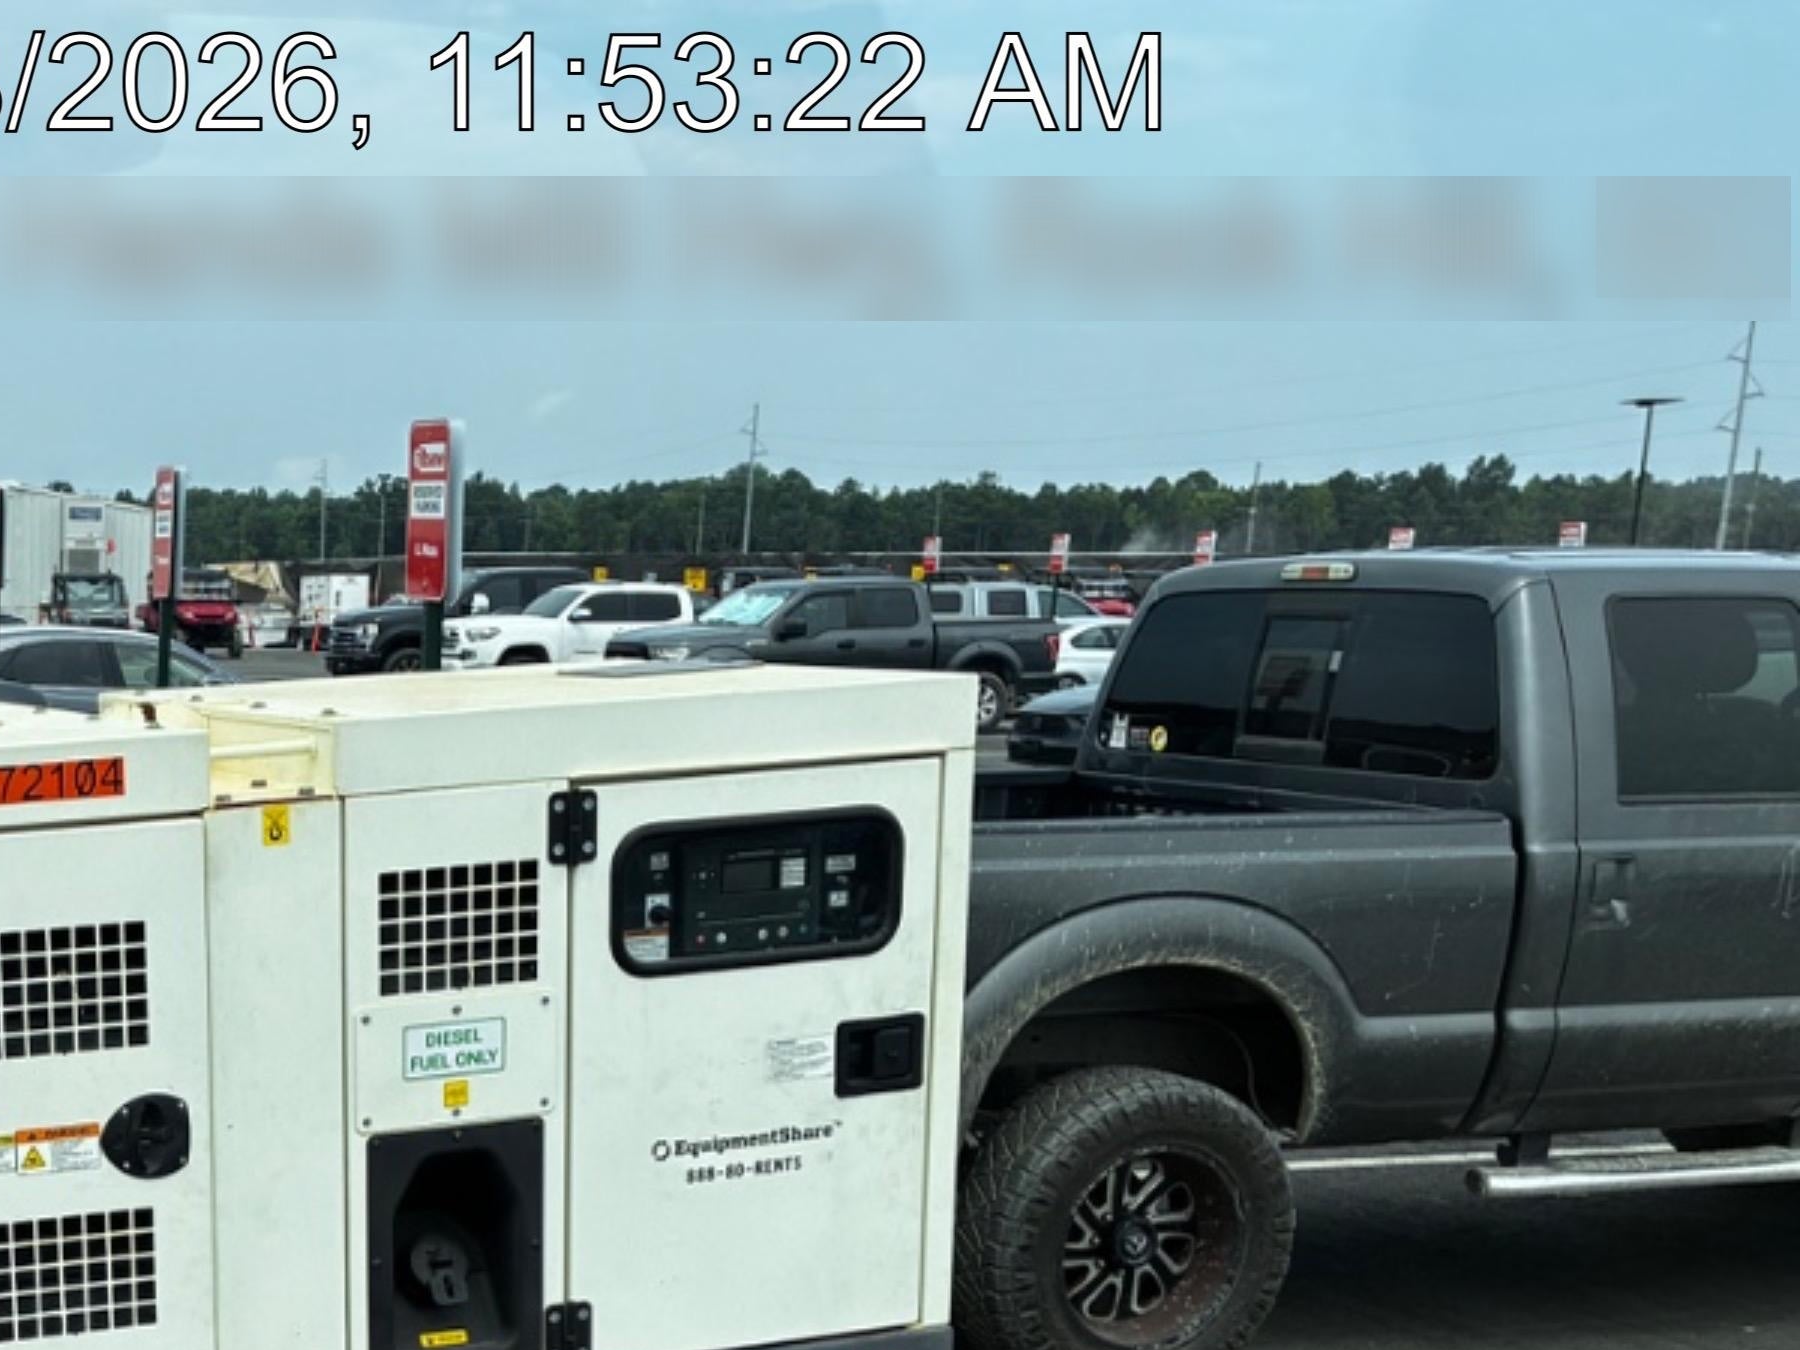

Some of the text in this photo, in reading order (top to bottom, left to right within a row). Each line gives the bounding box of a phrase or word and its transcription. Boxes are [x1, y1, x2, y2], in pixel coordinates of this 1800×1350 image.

[425, 1028, 484, 1049] DIESEL
[410, 1047, 498, 1072] FUEL ONLY
